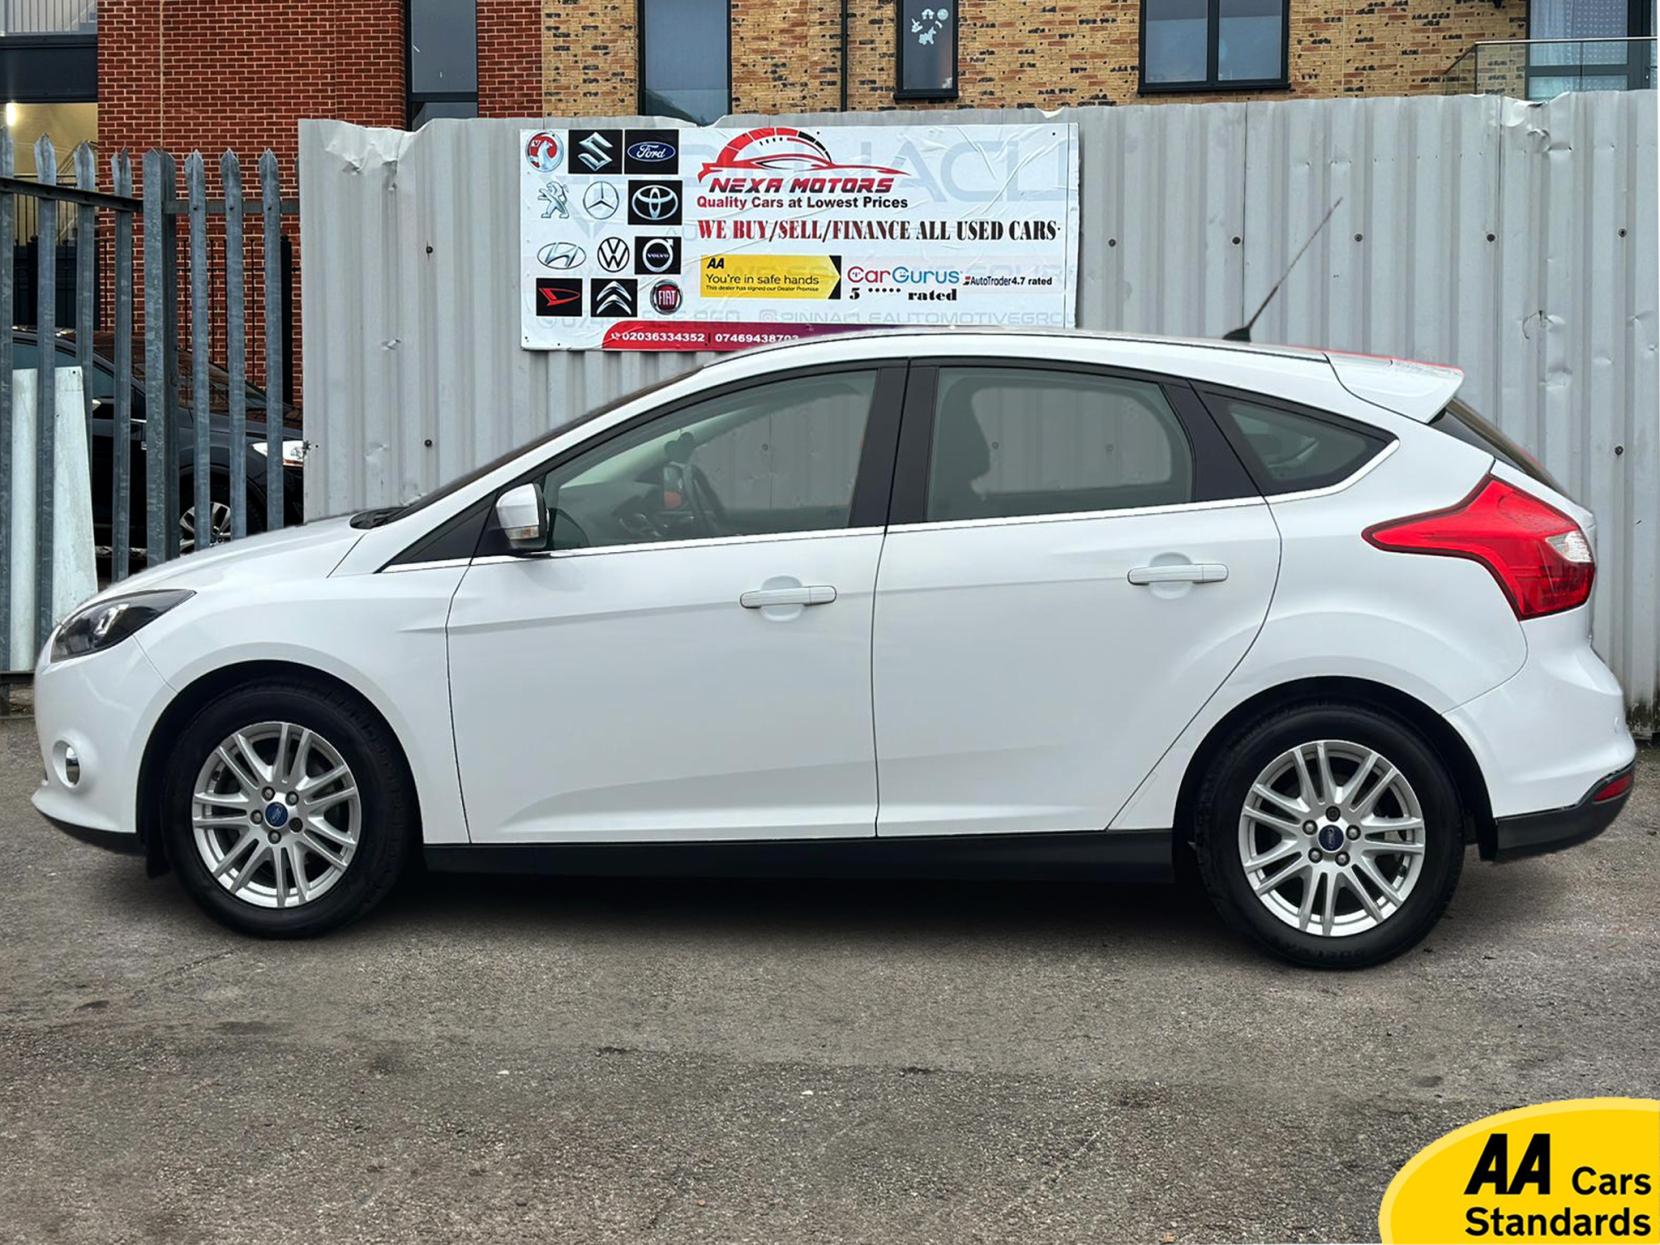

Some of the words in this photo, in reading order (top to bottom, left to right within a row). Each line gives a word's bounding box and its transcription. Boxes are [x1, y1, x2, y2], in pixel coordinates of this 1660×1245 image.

[637, 144, 666, 158] Ford
[709, 178, 783, 193] NEXA
[789, 178, 894, 193] MOTORS
[697, 196, 747, 210] Quality
[752, 196, 784, 208] Cars
[788, 196, 802, 208] at
[807, 195, 858, 208] Lowest
[863, 195, 908, 208] Prices
[698, 220, 727, 240] WE
[733, 220, 910, 242] BUY/SELL/FINANCE
[916, 221, 950, 241] ALL
[957, 221, 1004, 241] USED
[706, 258, 725, 269] AA
[706, 273, 741, 284] You're
[744, 274, 754, 284] in
[757, 274, 781, 285] safe
[784, 275, 820, 285] hands
[847, 266, 960, 284] CarGurus
[1028, 277, 1053, 286] rated
[658, 290, 676, 305] FIAT
[849, 288, 861, 300] 5
[908, 289, 957, 301] rated
[622, 333, 705, 341] 02036334352
